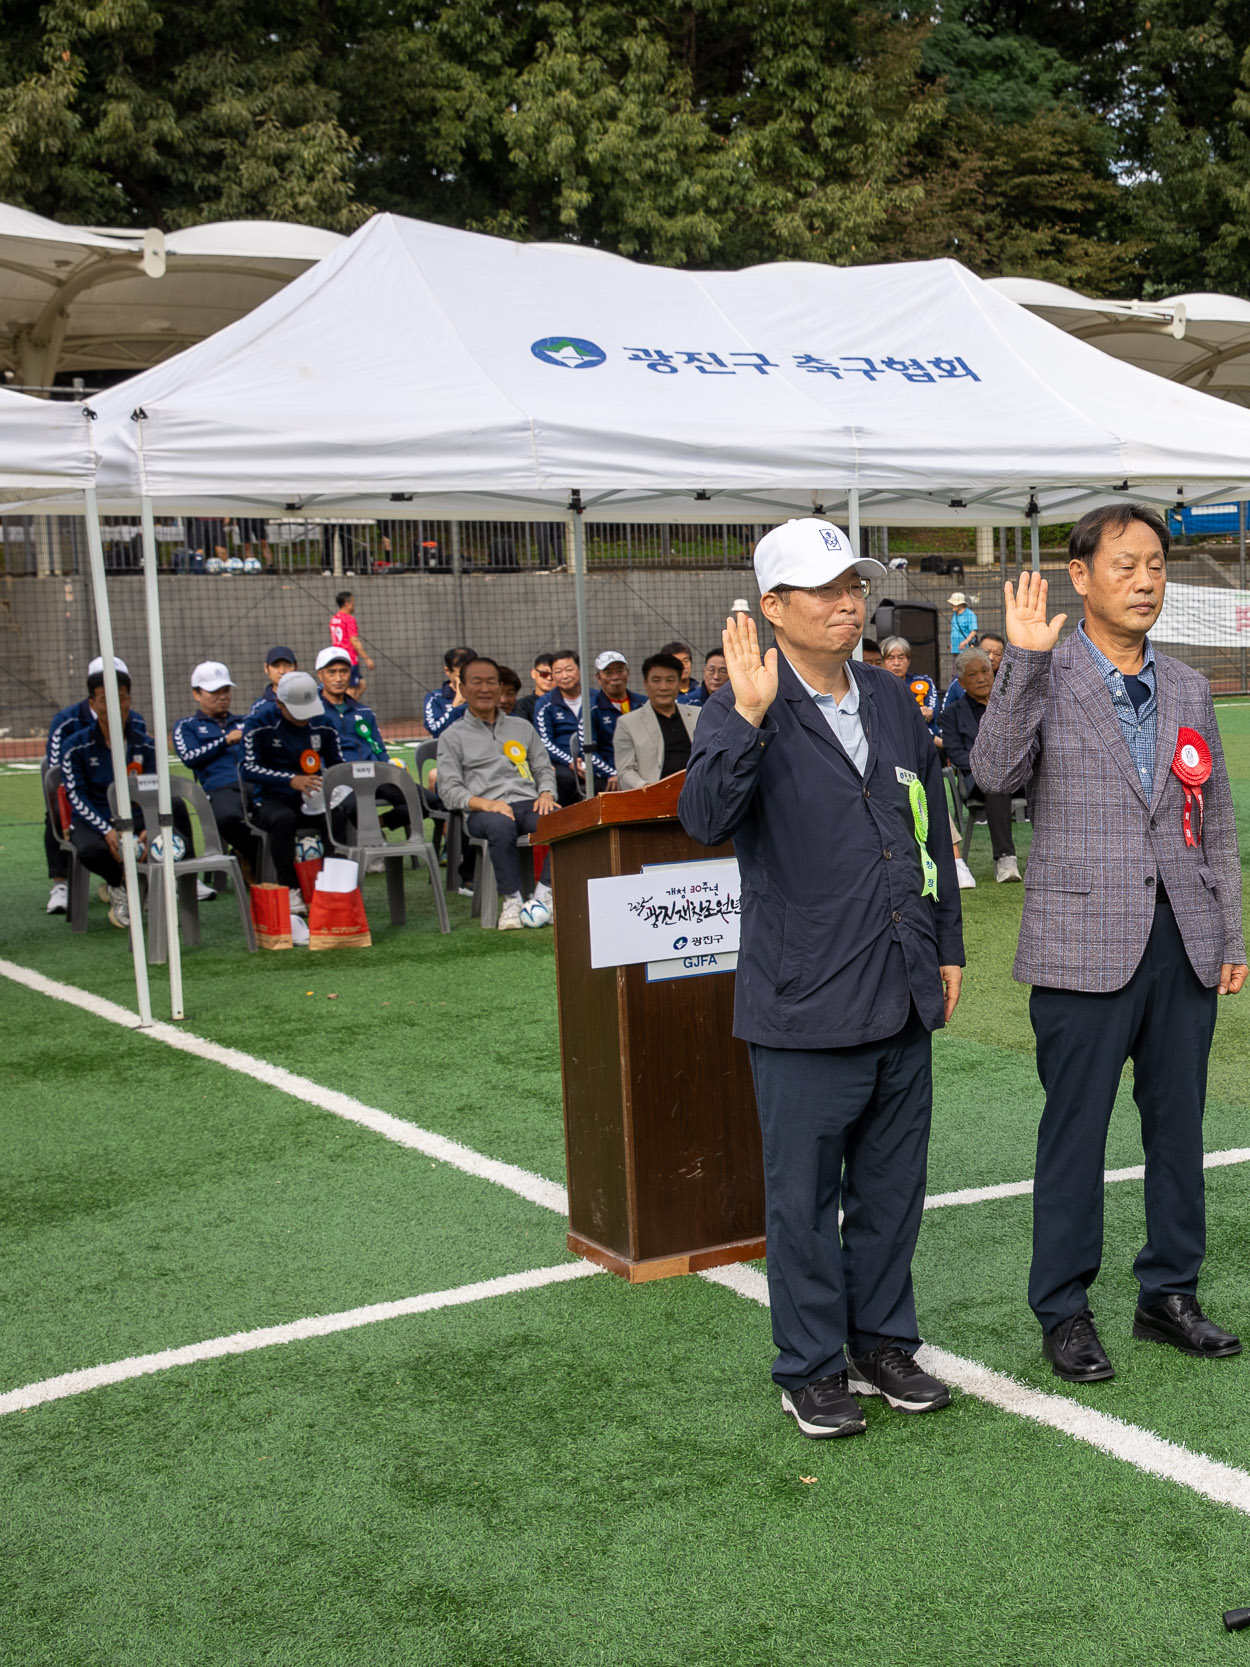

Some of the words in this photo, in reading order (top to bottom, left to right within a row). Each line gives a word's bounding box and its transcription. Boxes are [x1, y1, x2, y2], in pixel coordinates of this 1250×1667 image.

[622, 346, 780, 376] 광진구
[792, 354, 982, 384] 축구협회
[665, 886, 686, 899] 개청
[690, 881, 719, 896] 30주년
[691, 934, 724, 947] 광진구
[683, 954, 718, 969] GJFA
